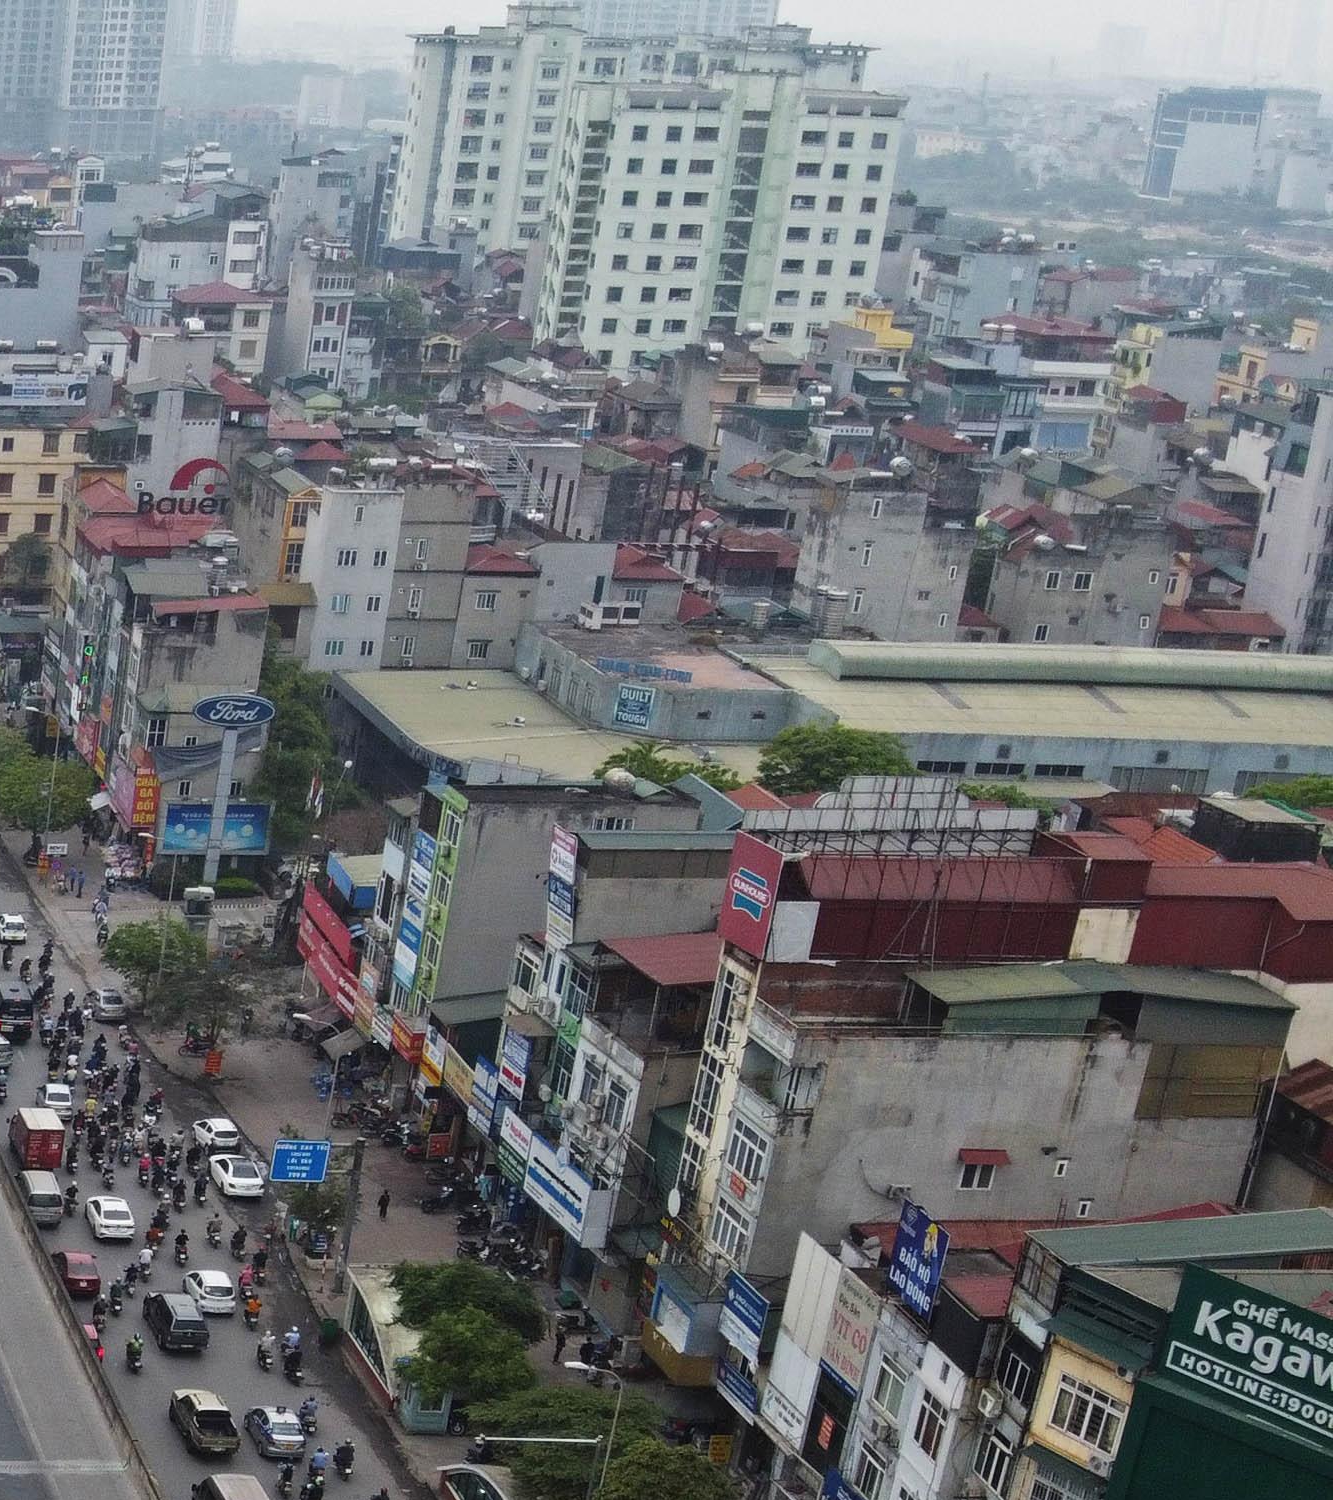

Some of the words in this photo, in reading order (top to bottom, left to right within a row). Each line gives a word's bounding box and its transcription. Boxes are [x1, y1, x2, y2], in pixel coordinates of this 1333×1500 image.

[138, 491, 231, 516] Bauer
[620, 687, 651, 703] BUILT
[209, 700, 261, 721] Ford
[617, 711, 647, 725] TOUGH
[899, 1246, 918, 1272] BẢO
[889, 1264, 907, 1289] LAO
[1233, 1299, 1286, 1330] GHẾ
